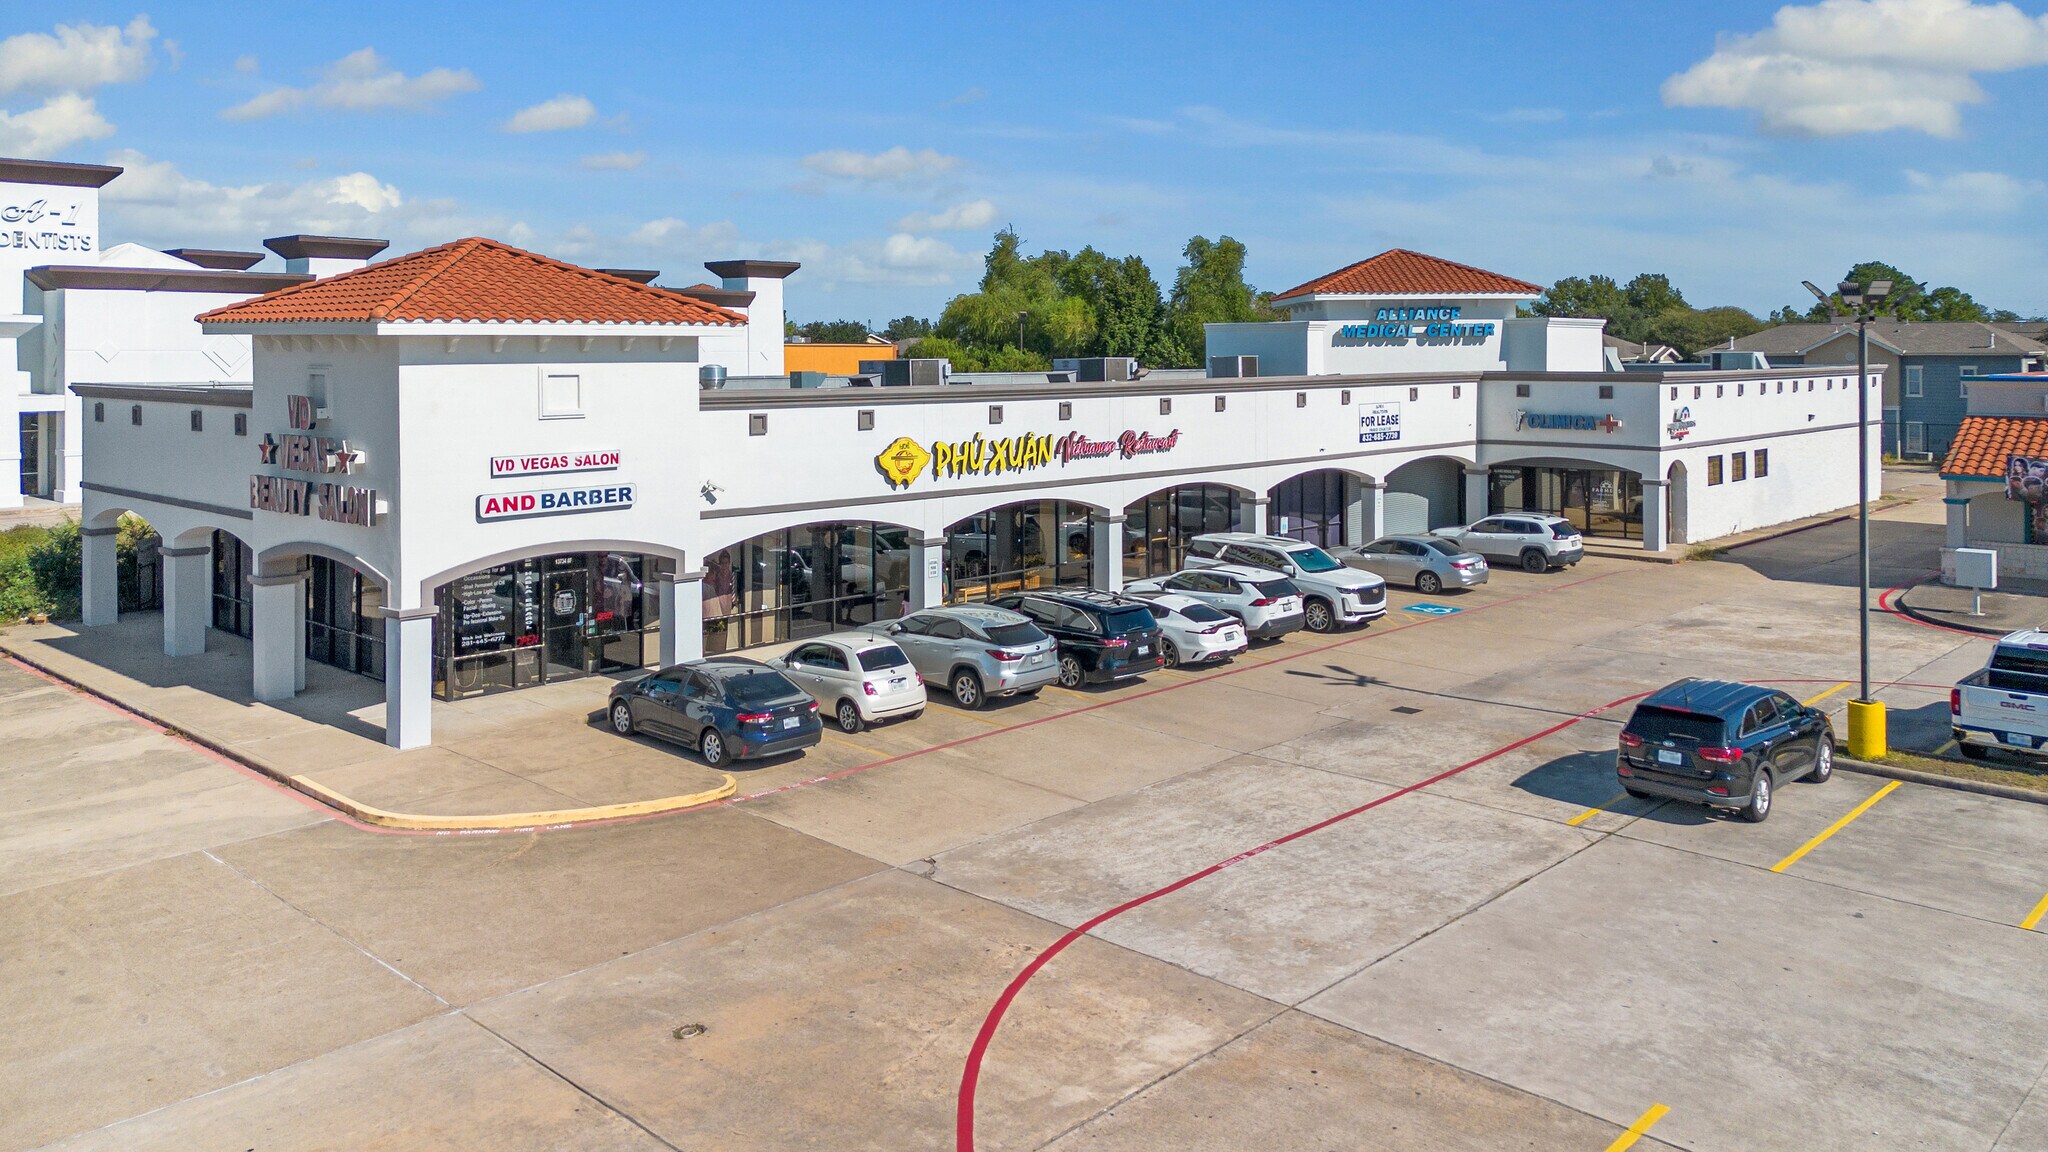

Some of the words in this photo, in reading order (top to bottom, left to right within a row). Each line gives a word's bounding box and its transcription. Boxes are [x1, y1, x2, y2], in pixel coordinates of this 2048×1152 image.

[1, 199, 82, 227] A-1
[0, 231, 91, 252] DENTISTS
[1376, 307, 1461, 320] ALLIANCE
[1342, 324, 1417, 338] MEDICAL
[1427, 323, 1495, 338] CENTER
[287, 395, 314, 430] VD
[1361, 416, 1375, 427] FOR
[1377, 414, 1399, 426] LEASE
[1528, 413, 1596, 430] CLINICA
[280, 434, 332, 473] VEGAS
[989, 431, 1054, 472] XUÂN
[1120, 429, 1183, 458] Restaurant
[495, 459, 514, 472] VD
[521, 455, 569, 471] VEGAS
[574, 453, 619, 467] SALON
[250, 475, 312, 516] BEAUTY
[319, 483, 375, 527] SALON
[484, 495, 536, 514] AND
[541, 487, 632, 509] BARBER
[2000, 701, 2036, 712] GMC
